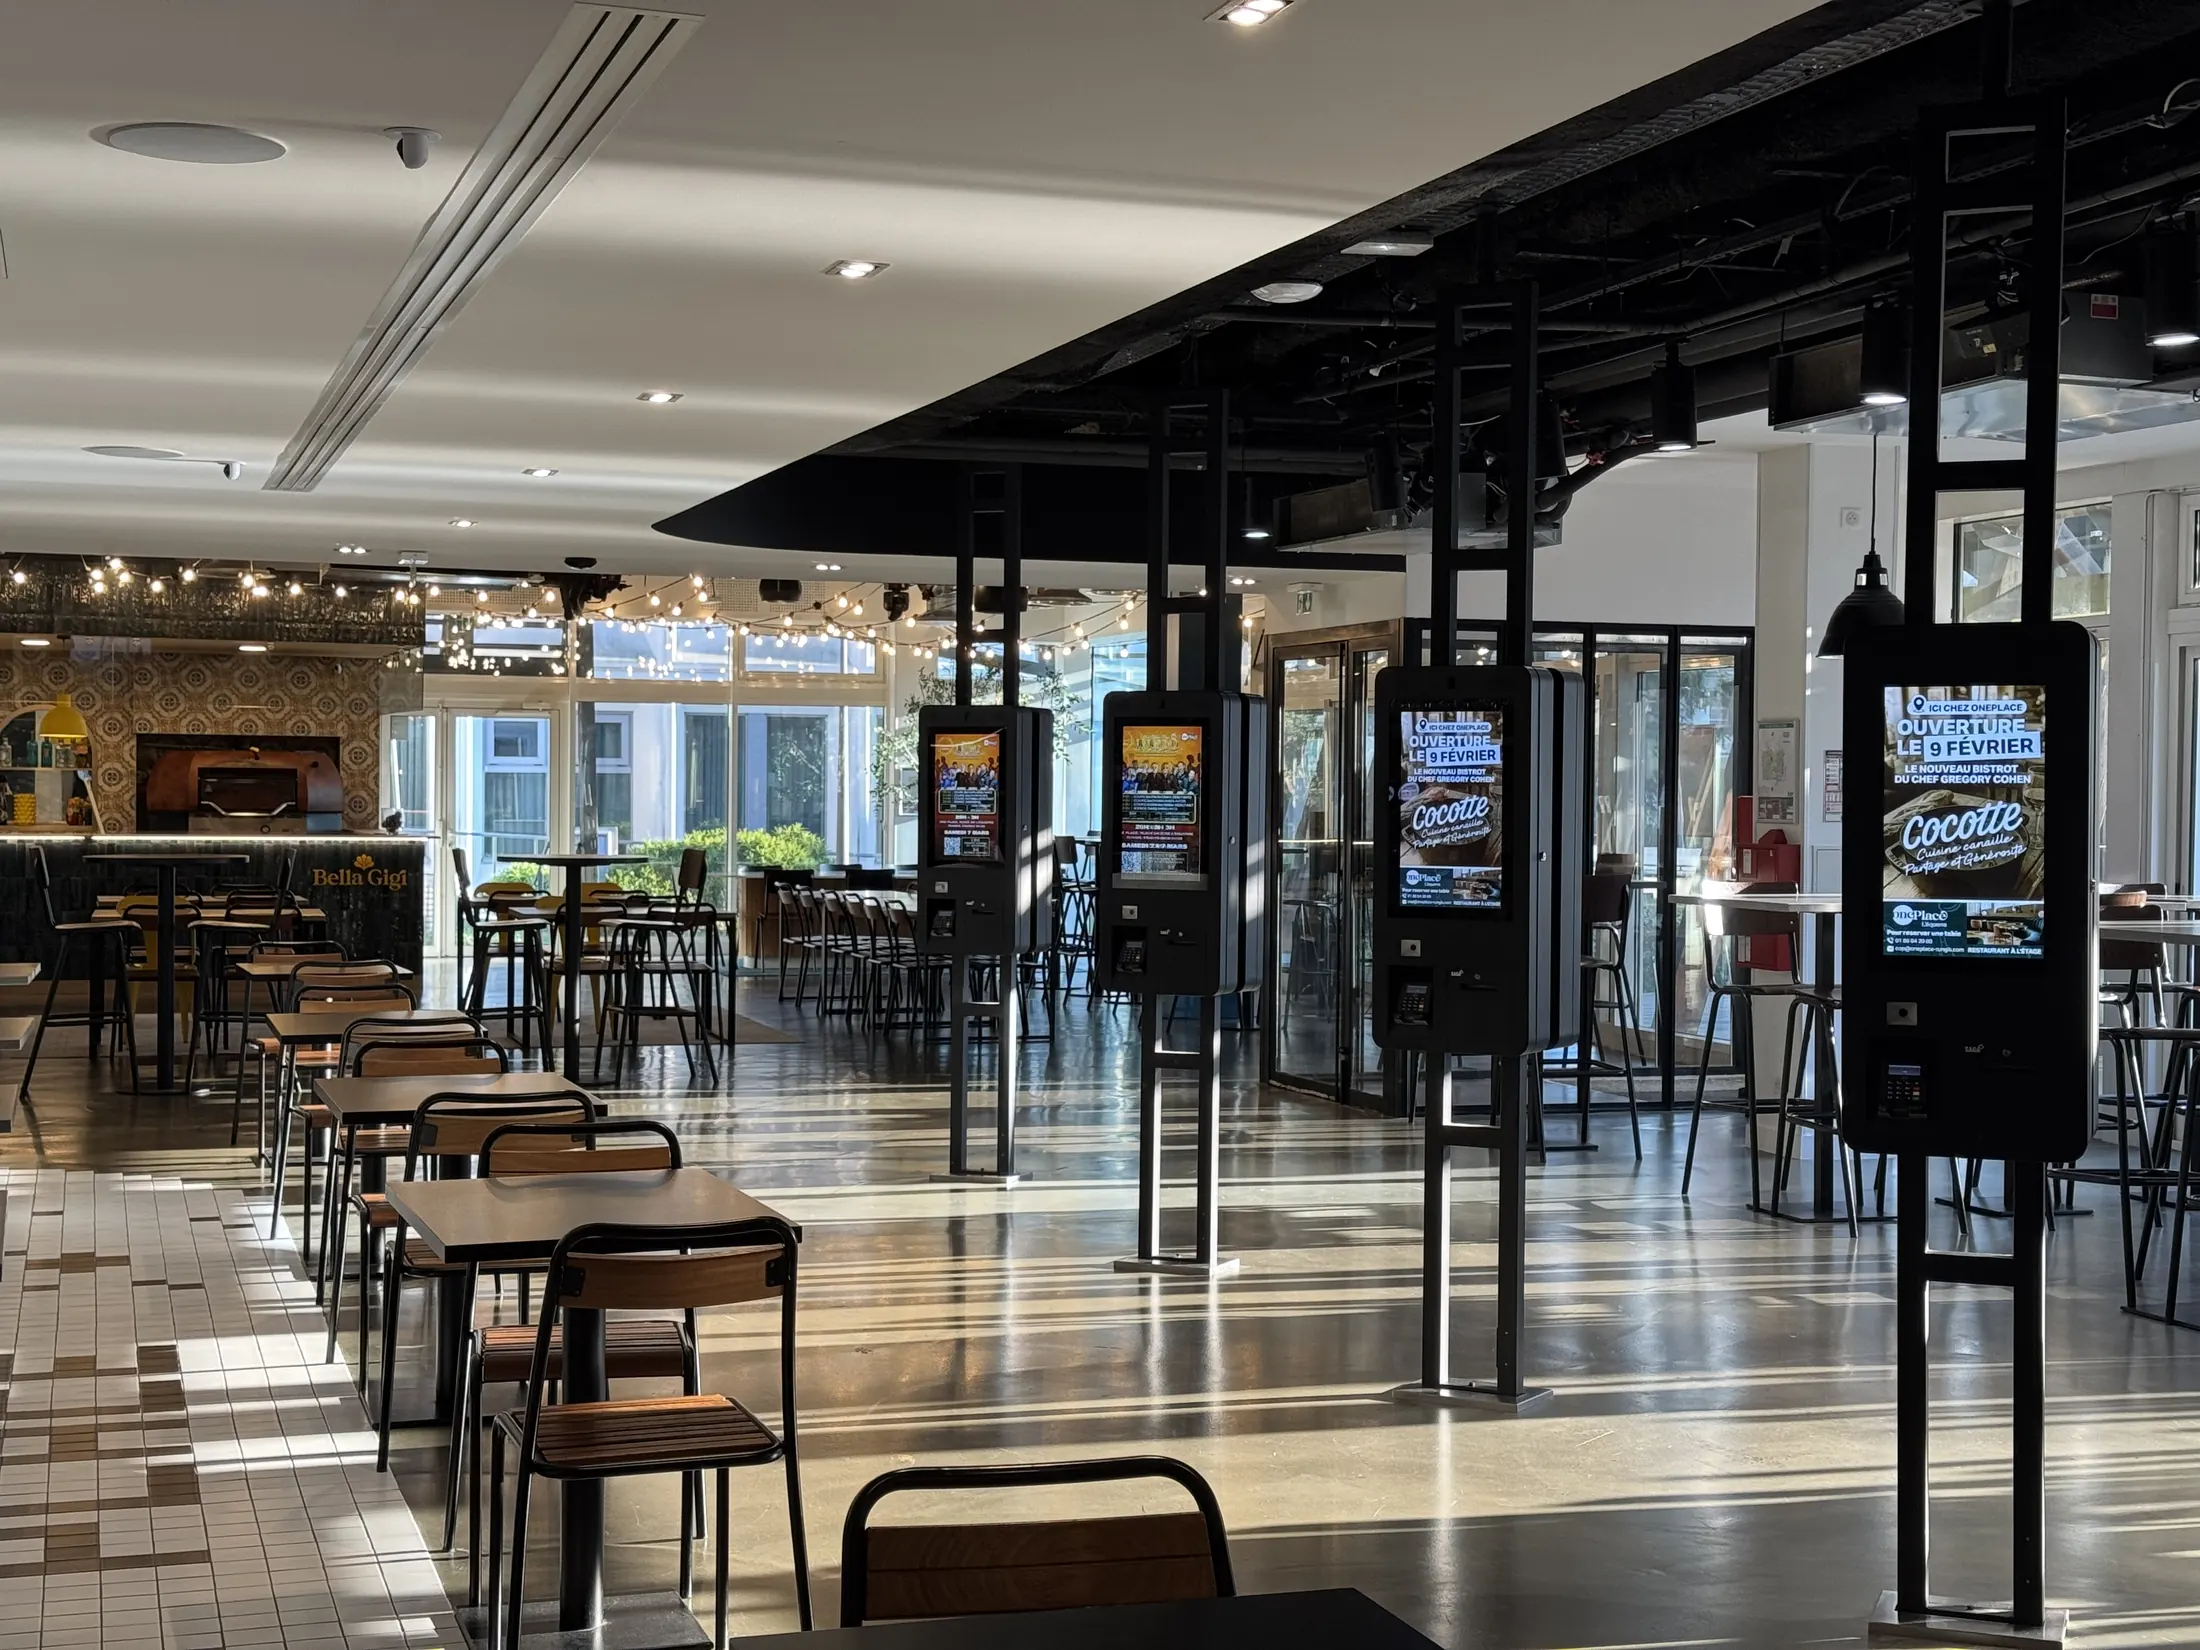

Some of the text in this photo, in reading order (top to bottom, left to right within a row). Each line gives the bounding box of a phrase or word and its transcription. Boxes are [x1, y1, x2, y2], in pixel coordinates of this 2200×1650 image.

[1929, 703, 2023, 712] ICI CHEZ ONEPLACE
[1897, 718, 2026, 736] OUVERTURE
[1409, 735, 1491, 748] OUVERTURE
[1897, 736, 2034, 757] LE 9 FÉVRIER
[1409, 748, 1496, 763] LE 9 FÉVRIER
[1905, 764, 2019, 774] LE NOUVEAU BISTROT
[1894, 774, 2032, 784] DU CHEF GREGORY COHEN
[1412, 794, 1490, 830] Cocotte
[1421, 818, 1484, 838] Cuisine canaille
[1902, 800, 2024, 850] Cocotte
[1442, 834, 1452, 844] et
[1916, 833, 2014, 861] Cuisine canaille
[1903, 843, 2028, 876] Partage et Générosité
[312, 868, 408, 891] Bella Gigi
[1968, 947, 2010, 955] RESTAURANT
